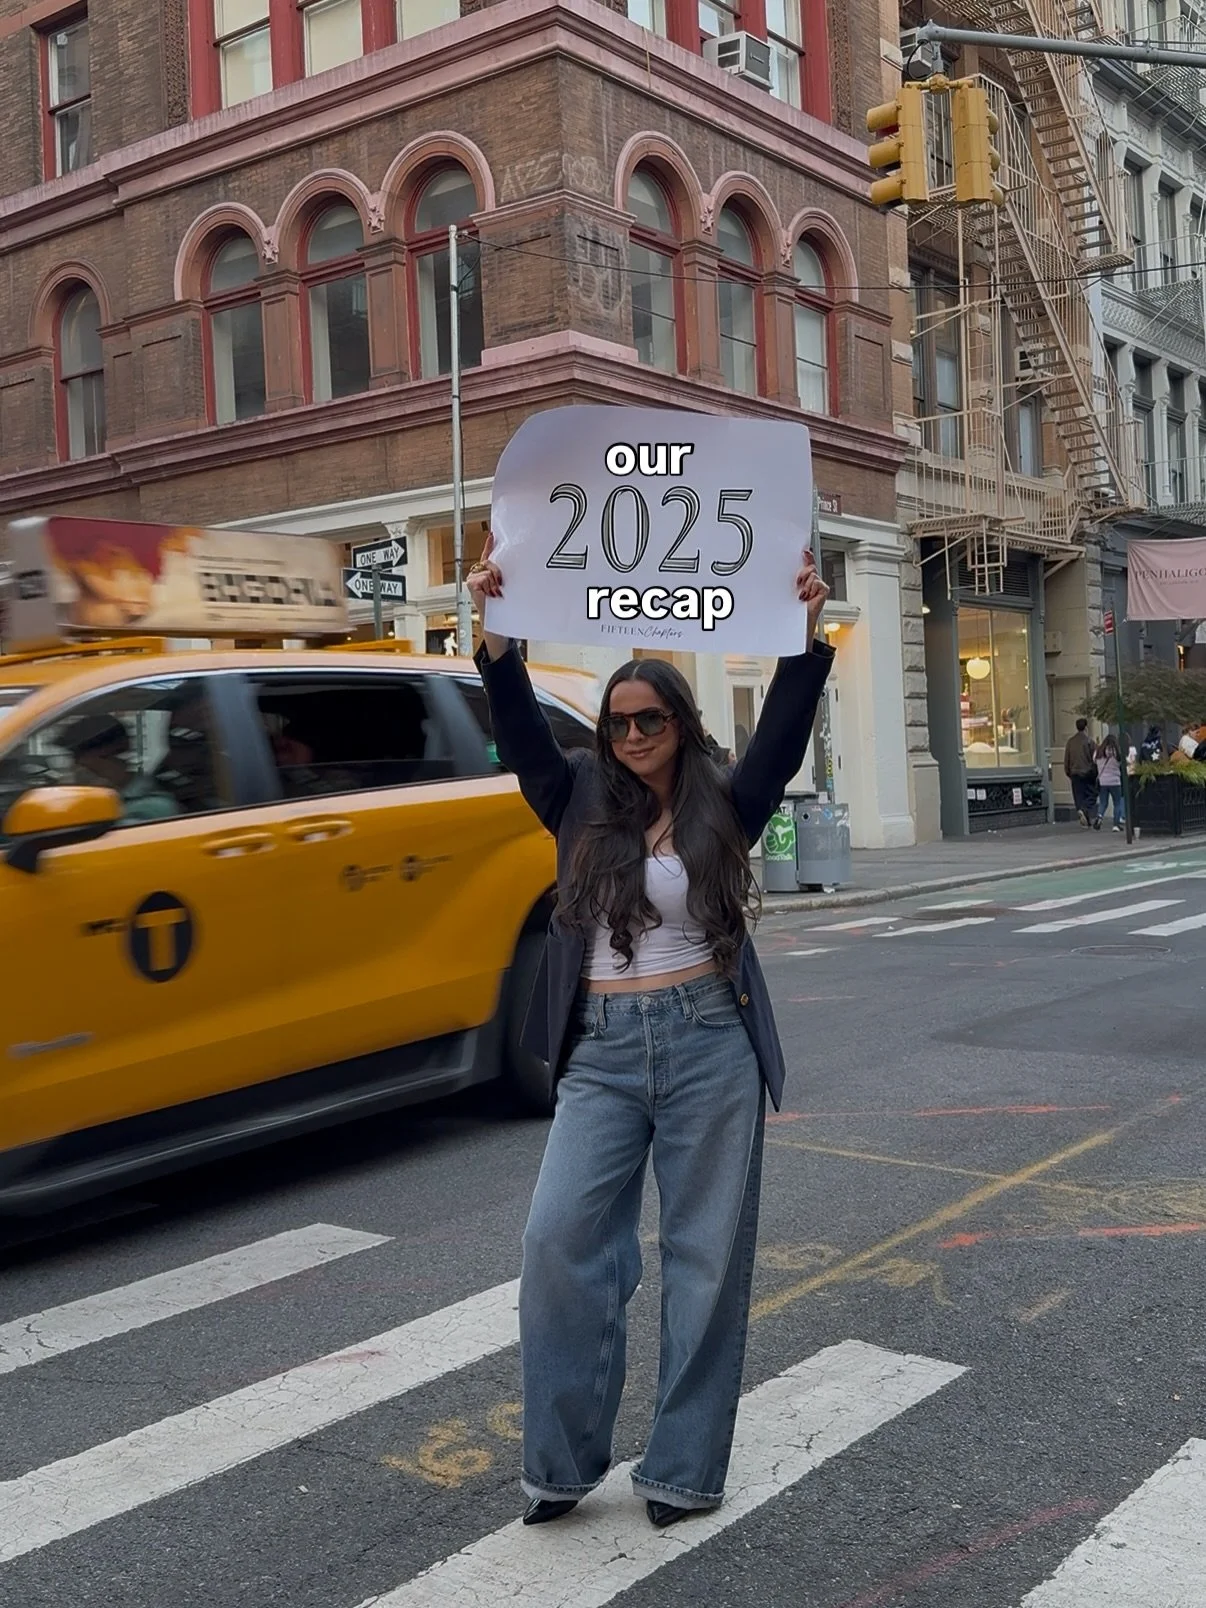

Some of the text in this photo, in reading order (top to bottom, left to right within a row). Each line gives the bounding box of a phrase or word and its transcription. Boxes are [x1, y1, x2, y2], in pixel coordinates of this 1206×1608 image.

[546, 483, 753, 576] 2025
[360, 546, 400, 566] ONE WAY
[354, 579, 398, 594] ONE WAY
